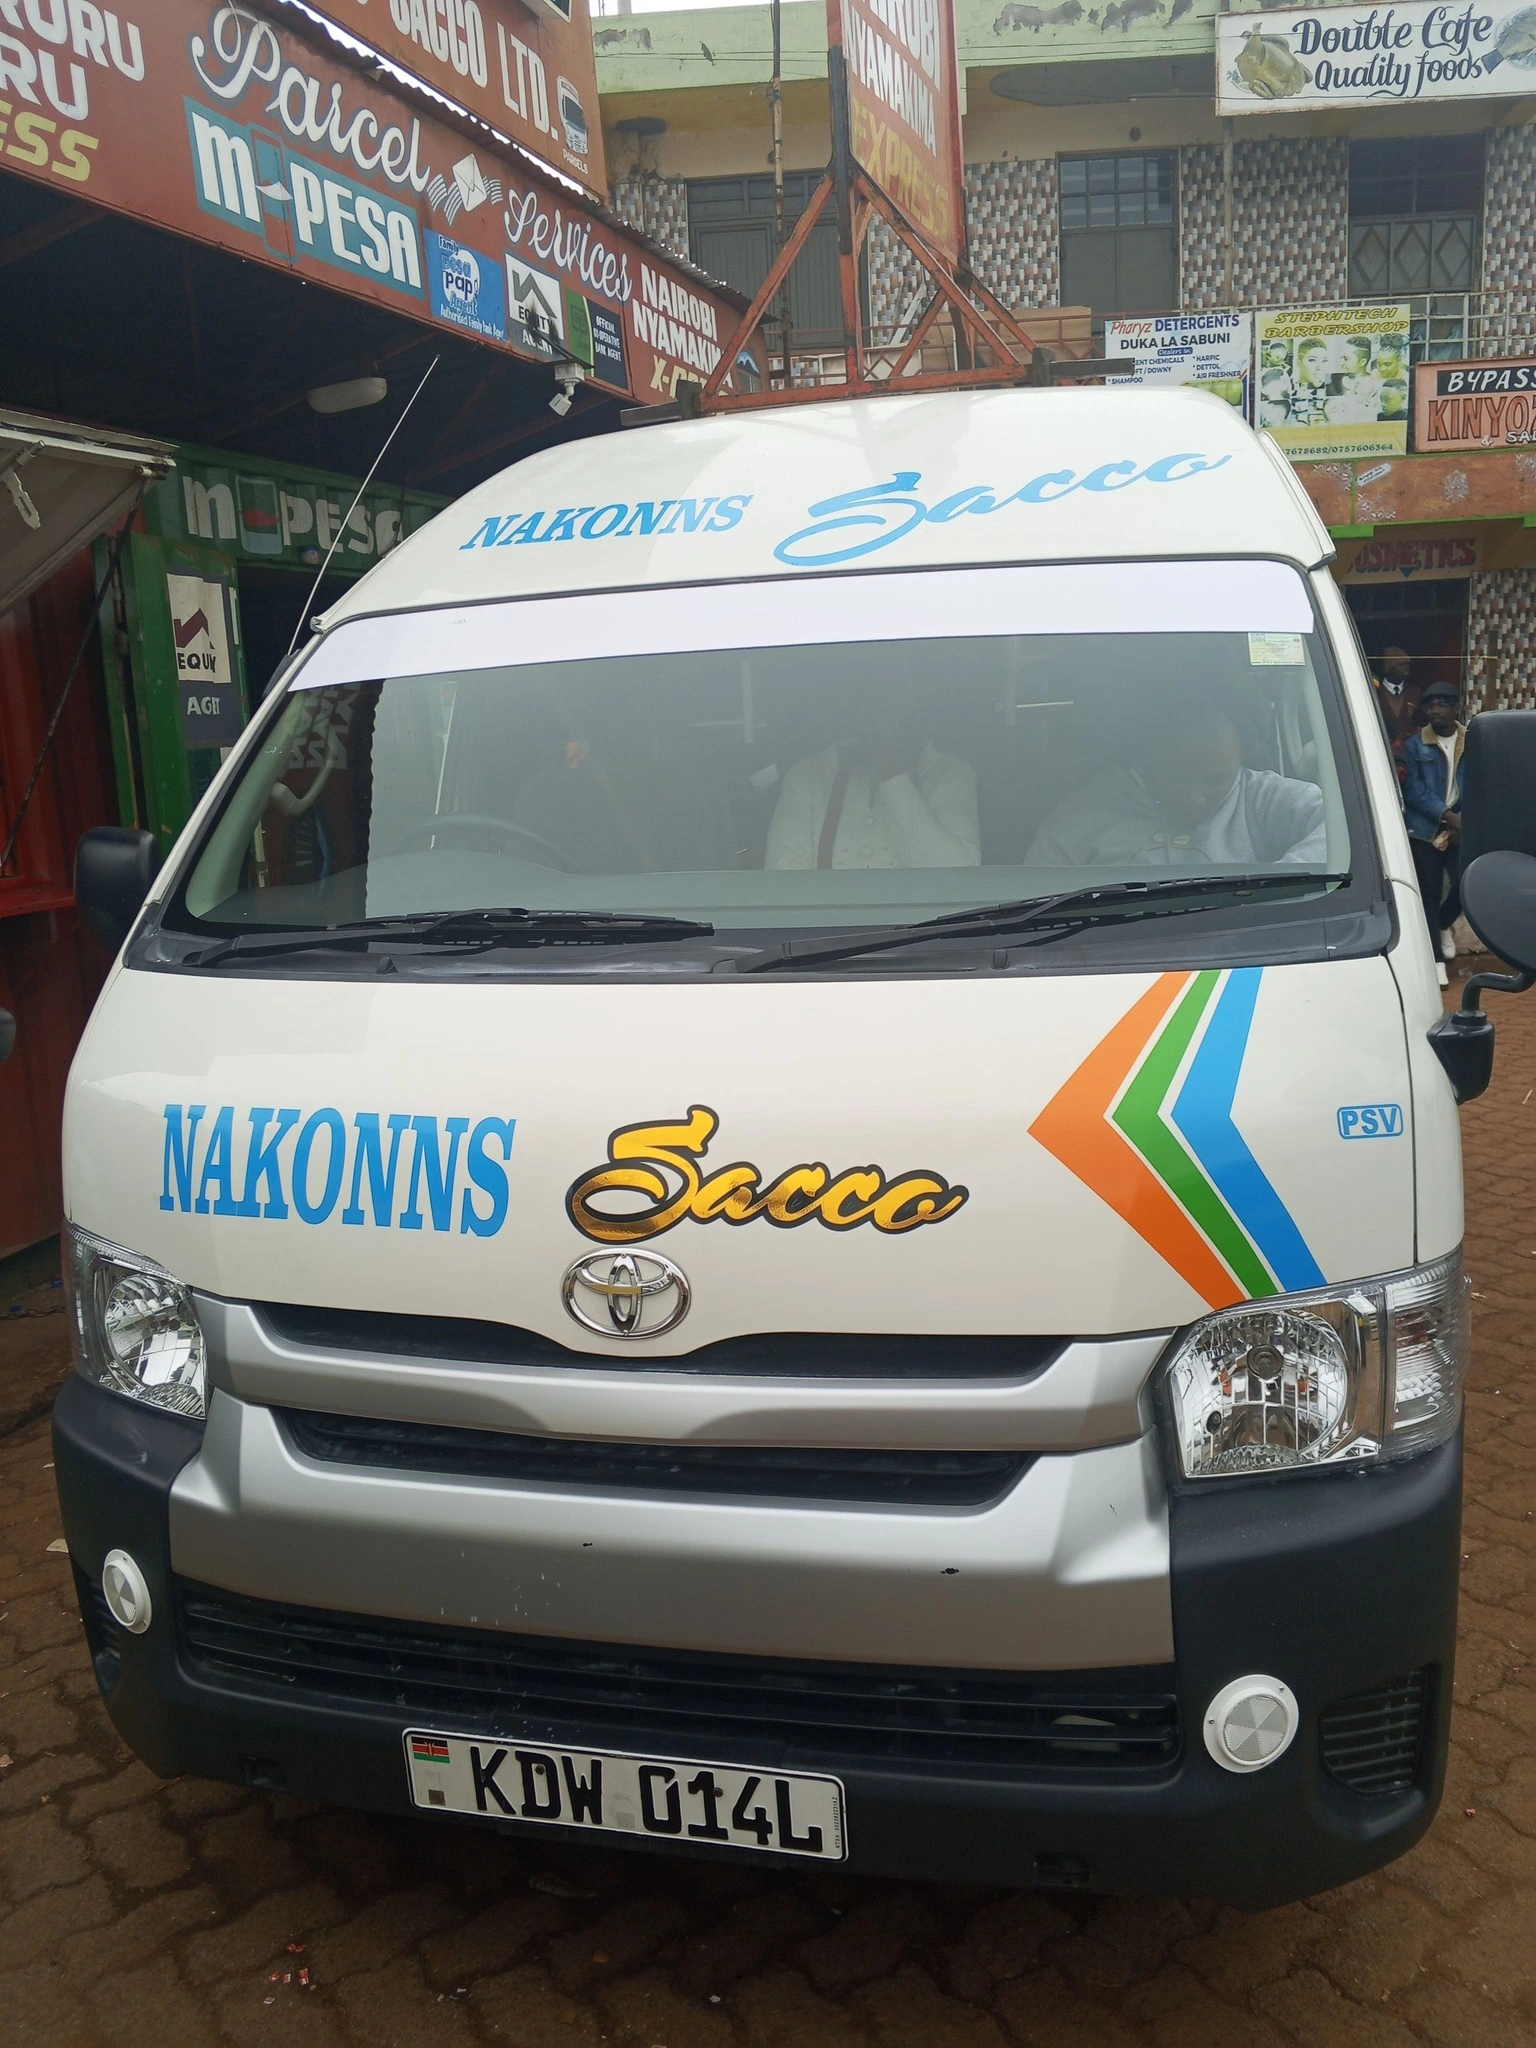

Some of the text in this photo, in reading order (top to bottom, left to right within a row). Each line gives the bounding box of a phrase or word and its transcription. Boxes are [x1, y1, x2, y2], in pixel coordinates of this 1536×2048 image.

[1291, 4, 1494, 57] Double Cafe
[496, 22, 560, 142] LTD.
[1315, 52, 1413, 99] Quality
[190, 7, 633, 302] Parcel Services
[851, 98, 950, 243] EXPRESS
[438, 234, 460, 256] Family
[445, 271, 473, 301] pap
[640, 262, 718, 342] NAIROBI
[595, 315, 616, 334] OFFICIAL
[1155, 314, 1240, 333] DETERGENTS
[1274, 307, 1399, 324] STEPHTECH
[1264, 320, 1410, 339] BARBERSHOP
[1120, 332, 1231, 350] DUKA LA SABUNI
[607, 346, 622, 362] AGENT
[1149, 356, 1185, 365] CHEMICALS
[1196, 354, 1220, 362] HARPIC
[1147, 366, 1172, 374] DOWNY
[1196, 363, 1221, 371] DETTOL
[1208, 370, 1242, 379] FRESHNER
[1111, 377, 1144, 385] SHAMPOO
[1281, 443, 1394, 456] 7678682/0757606364
[1481, 434, 1494, 447] &
[458, 453, 1233, 567] NAKONNS Sacco
[1341, 1107, 1398, 1136] PSV
[159, 1103, 970, 1247] NAKONNS Sacco
[470, 1745, 824, 1853] KDW 014L
